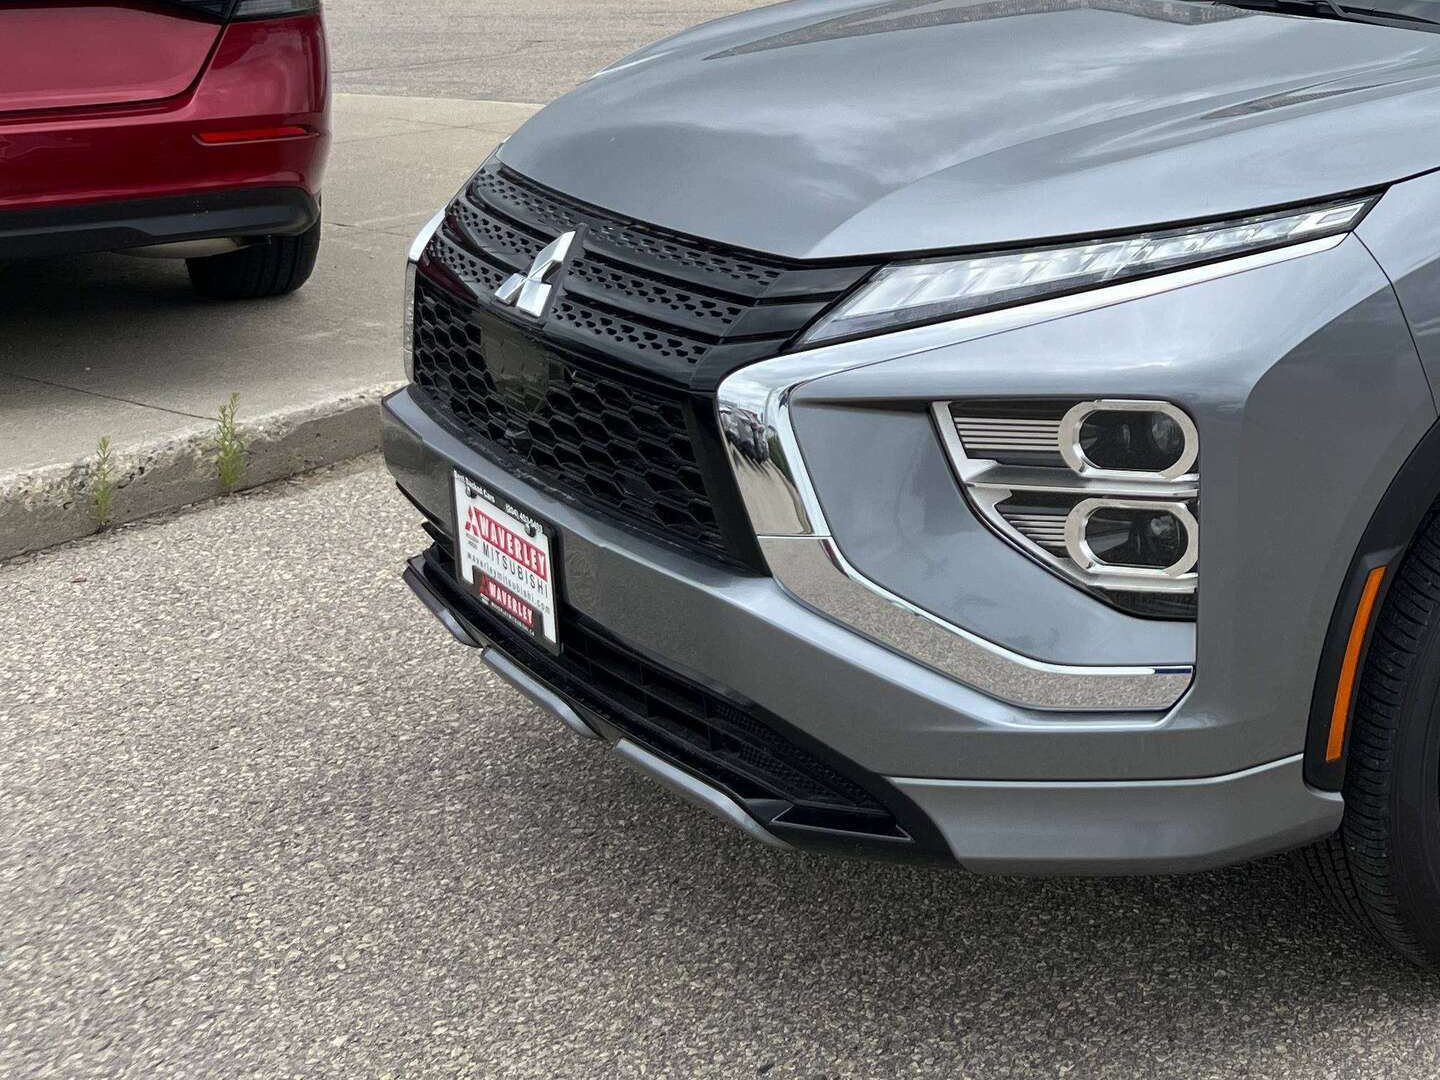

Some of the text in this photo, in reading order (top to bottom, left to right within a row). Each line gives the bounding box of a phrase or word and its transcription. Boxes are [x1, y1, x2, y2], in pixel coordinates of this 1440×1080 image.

[479, 513, 547, 578] WAVERLEY
[482, 540, 549, 600] MITSUBISHI
[488, 580, 534, 626] WAVERLEY
